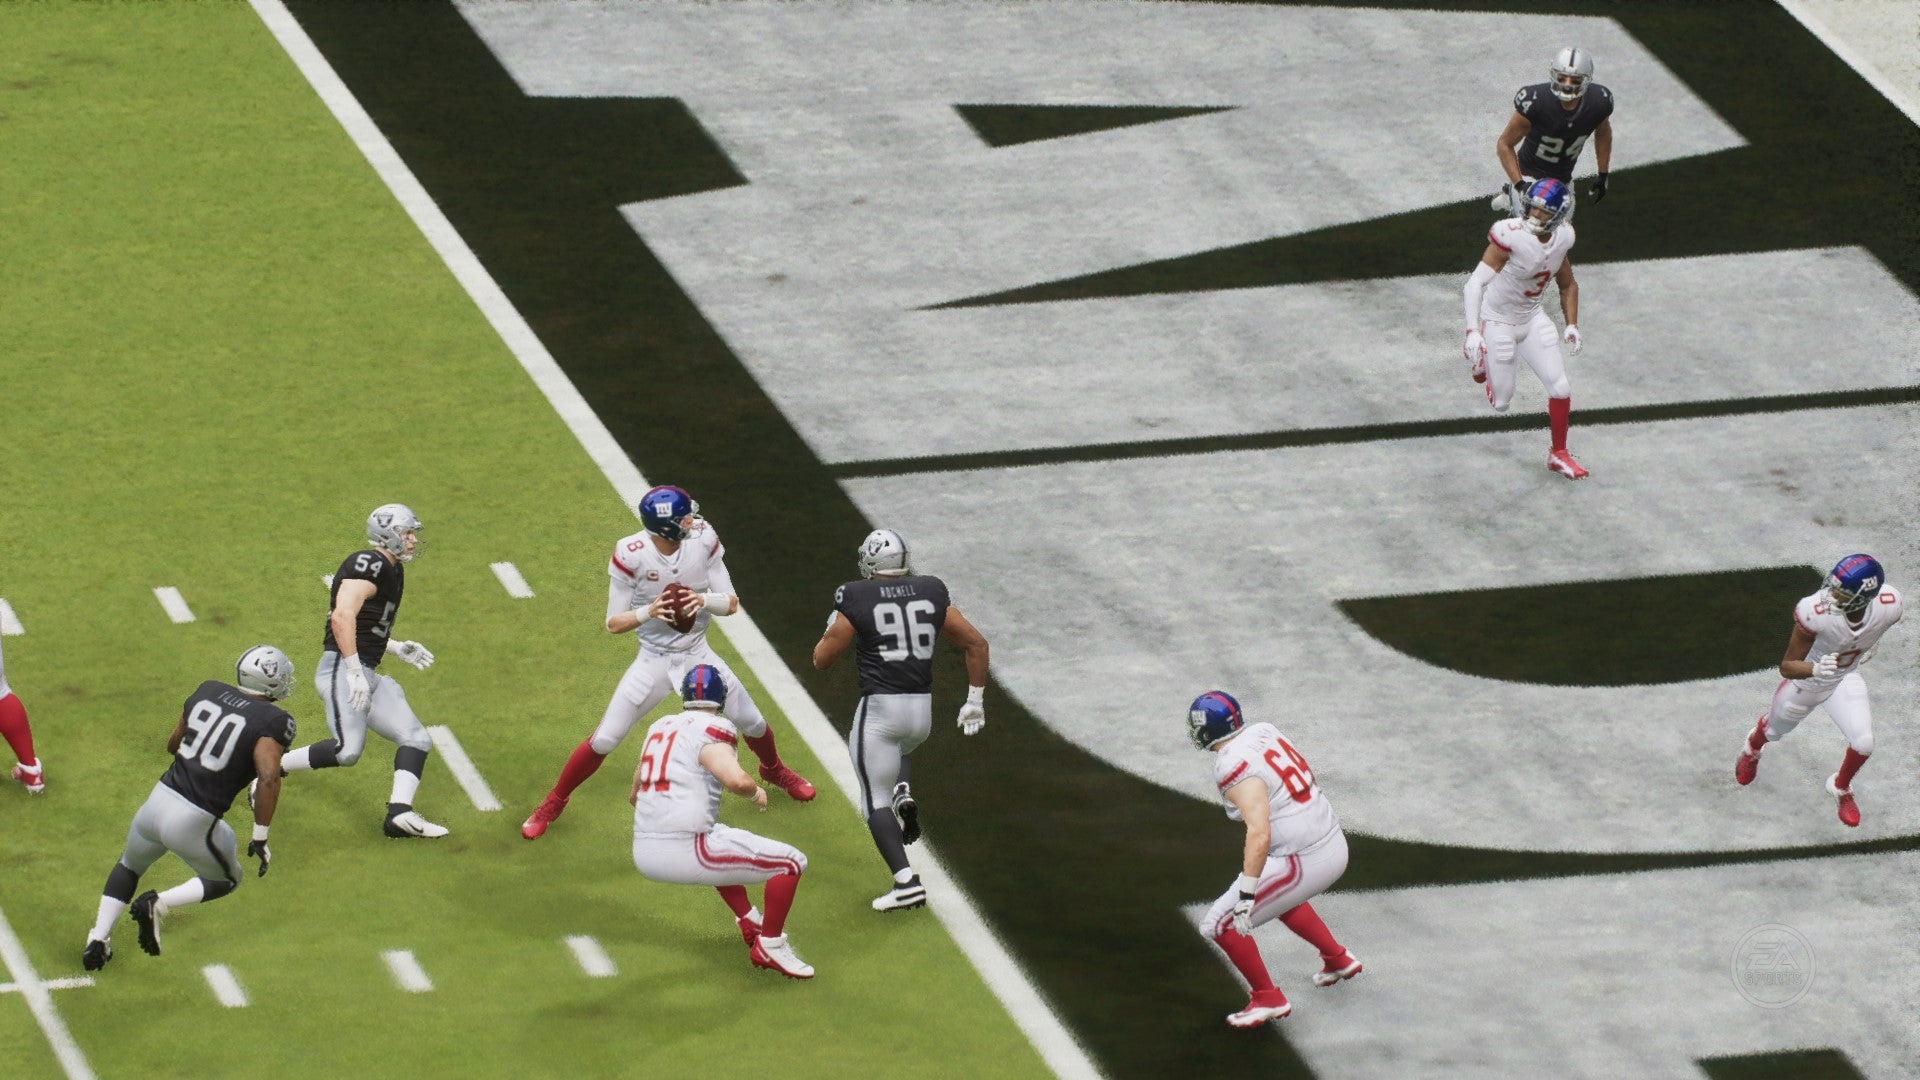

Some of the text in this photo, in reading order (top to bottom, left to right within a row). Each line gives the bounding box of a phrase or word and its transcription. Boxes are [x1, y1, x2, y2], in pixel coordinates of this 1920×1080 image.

[1515, 88, 1533, 115] 24
[1535, 134, 1588, 163] 24
[1524, 270, 1551, 297] 3
[627, 539, 645, 552] 8
[355, 553, 382, 577] 54
[880, 585, 916, 598] ROCHELL
[1879, 592, 1896, 605] 0
[873, 599, 935, 661] 96
[1836, 648, 1862, 669] 0
[177, 699, 247, 772] 90
[641, 731, 678, 792] 61
[1263, 737, 1316, 803] 64
